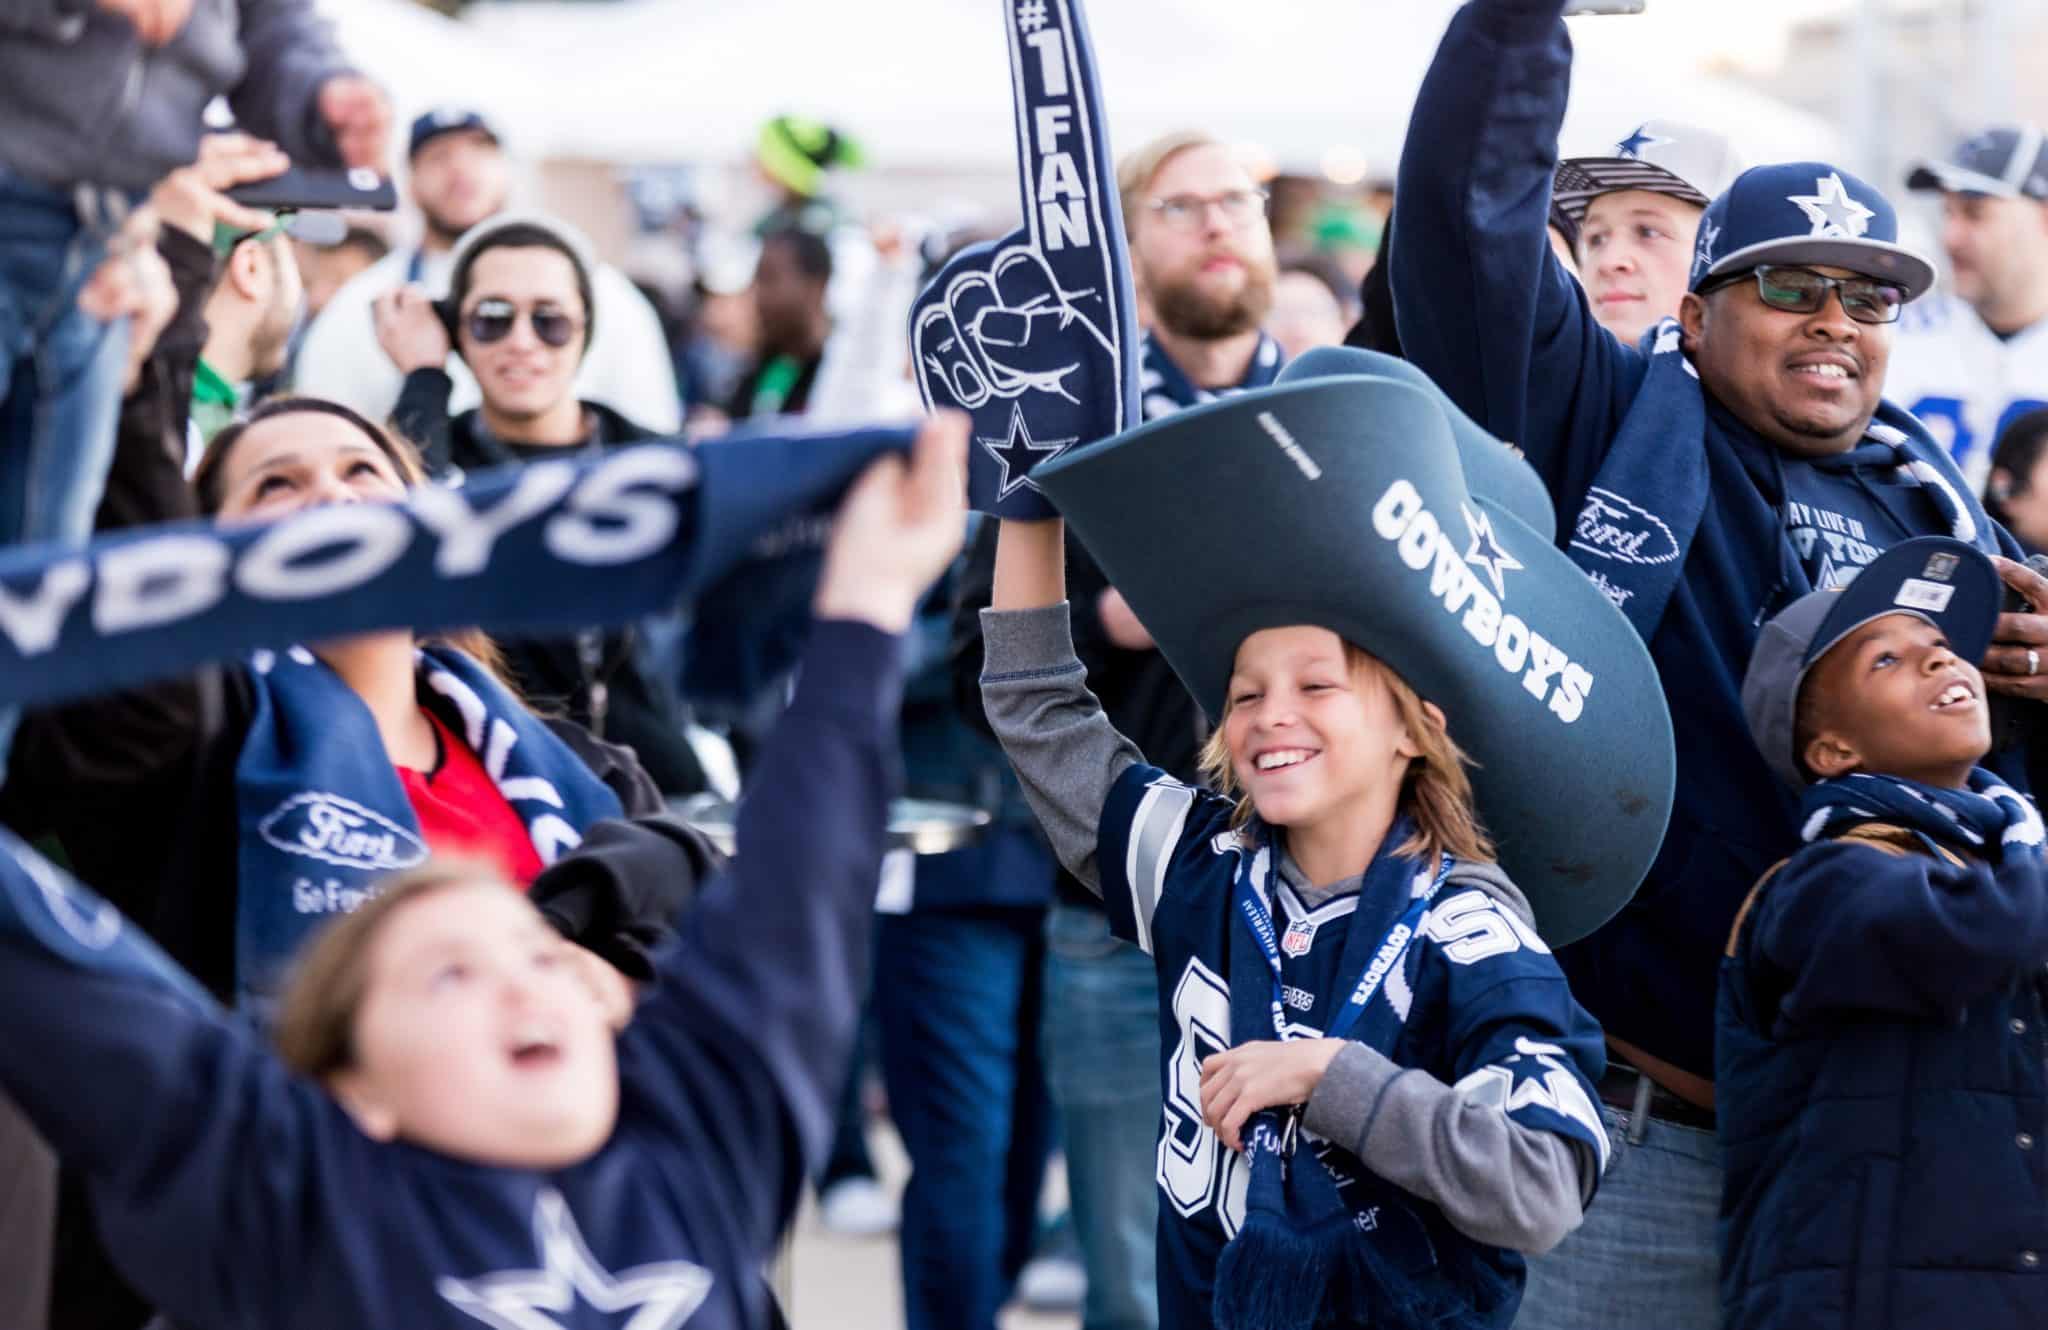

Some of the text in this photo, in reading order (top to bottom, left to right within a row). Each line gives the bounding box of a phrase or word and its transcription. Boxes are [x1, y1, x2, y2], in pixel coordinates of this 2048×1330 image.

[1034, 105, 1091, 250] FAN
[1576, 496, 1651, 556] Ford
[1789, 501, 1811, 526] AY
[1812, 507, 1850, 534] LIVE
[1373, 479, 1594, 723] COWBOYS
[299, 800, 397, 859] Ford
[1286, 932, 1308, 950] NFL
[1351, 923, 1412, 1006] COWBOYS
